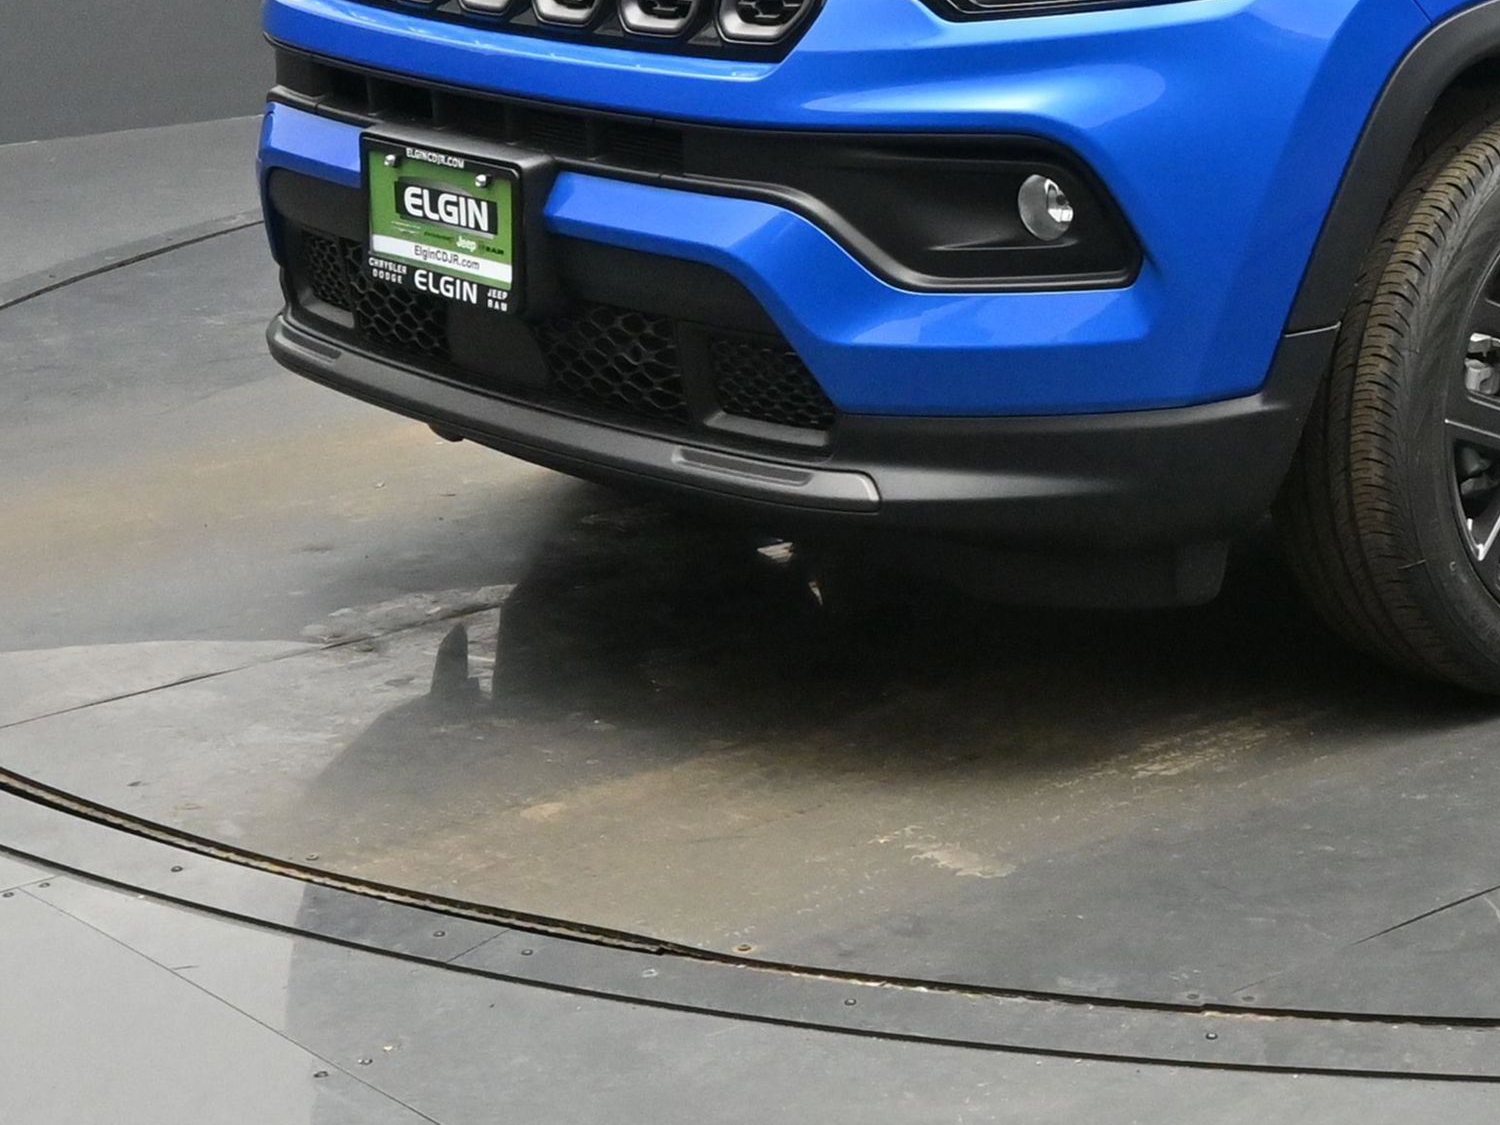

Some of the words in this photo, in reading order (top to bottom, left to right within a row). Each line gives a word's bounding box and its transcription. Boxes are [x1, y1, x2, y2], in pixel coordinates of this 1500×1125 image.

[406, 147, 464, 169] ELGINCDJR.COM
[404, 186, 489, 232] ELGIN
[456, 236, 477, 252] Jeep
[368, 257, 407, 275] CHRYSLER
[414, 245, 480, 270] ElginCDJR.com
[372, 268, 403, 284] DODGE
[414, 268, 478, 304] ELGIN
[487, 289, 508, 300] JEEP
[487, 300, 508, 312] RAM
